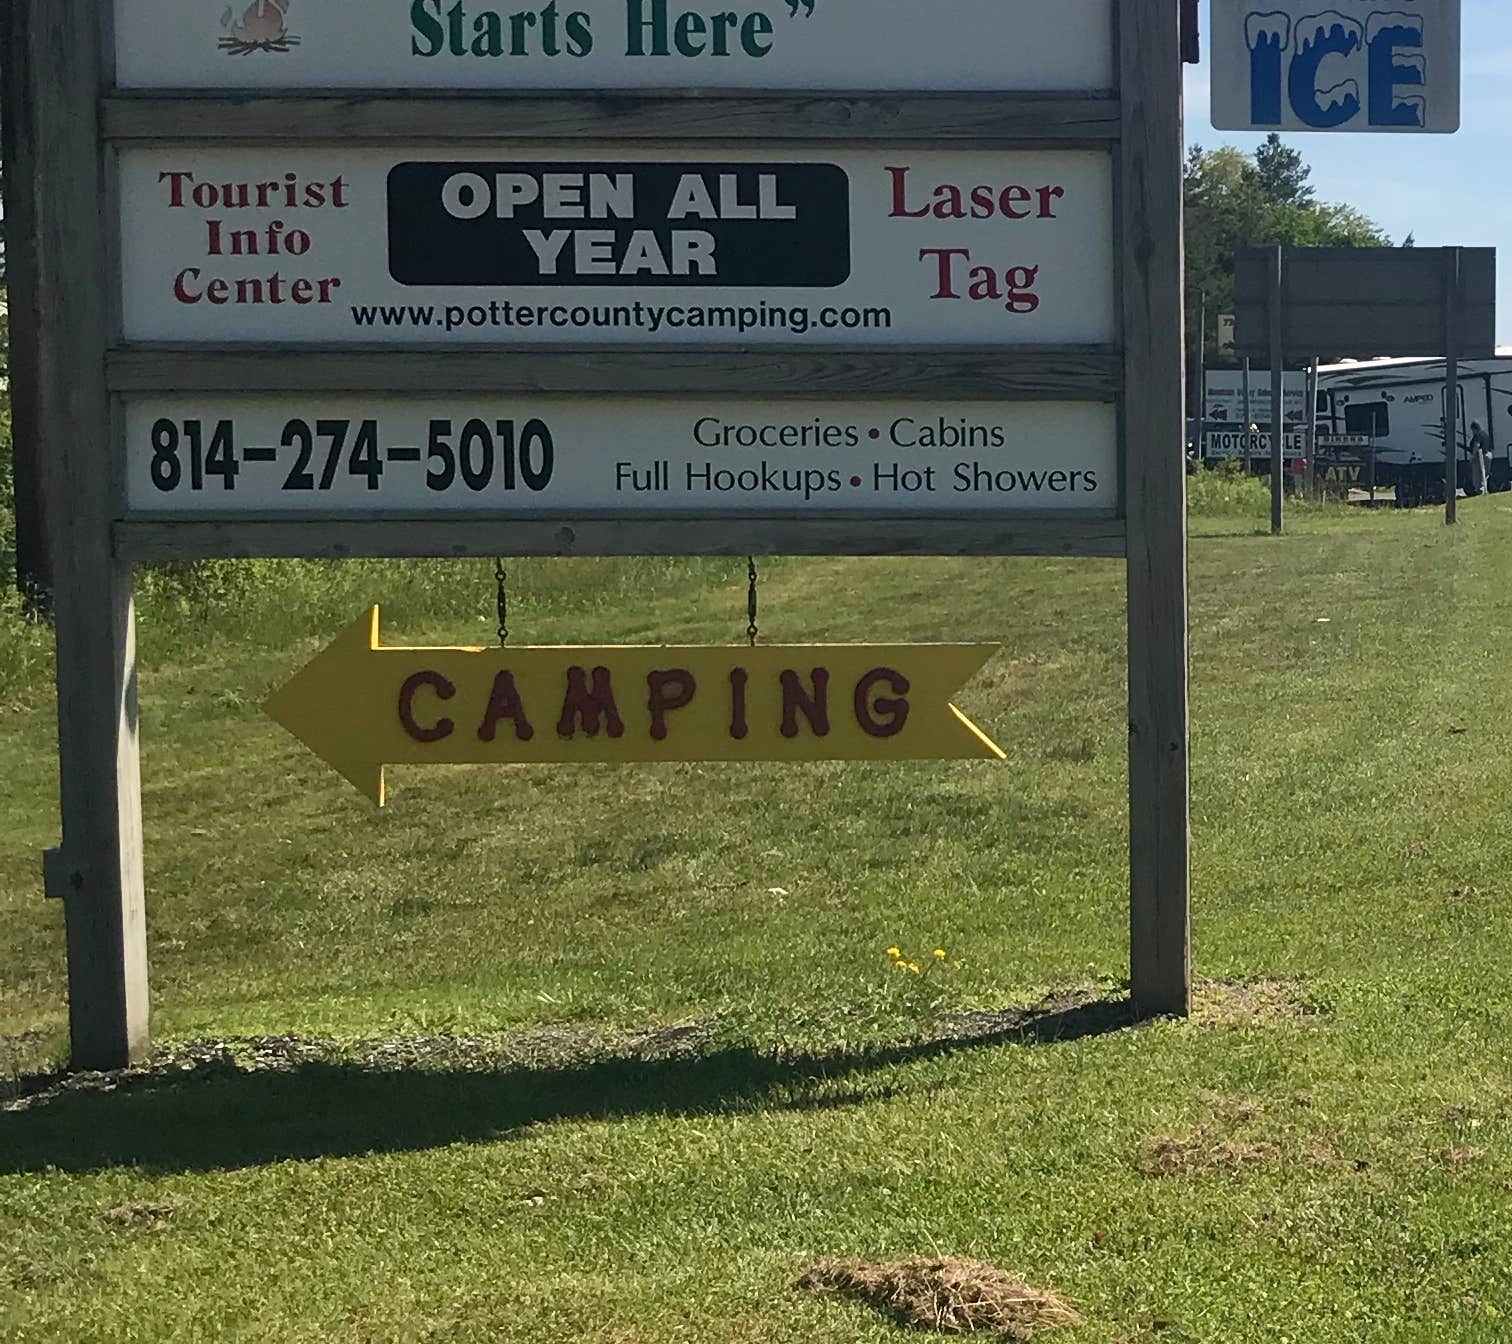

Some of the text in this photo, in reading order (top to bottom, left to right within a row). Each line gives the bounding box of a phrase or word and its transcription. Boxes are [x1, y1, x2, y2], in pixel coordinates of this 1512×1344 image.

[1243, 10, 1426, 129] ICE
[158, 172, 348, 208] Tourist
[442, 173, 796, 219] OPEN ALL
[886, 167, 1064, 219] Laser
[206, 220, 310, 255] Info
[522, 230, 717, 274] YEAR
[173, 268, 340, 304] Center
[919, 249, 1039, 313] Tag
[351, 301, 890, 333] www.pottercountycamping.com
[694, 417, 1004, 447] Groceries Cabins
[151, 418, 553, 491] 814-274-5010
[1326, 466, 1361, 481] ATV
[617, 461, 1097, 500] Full Hookups Hot Showers
[398, 666, 910, 742] CAMPING
